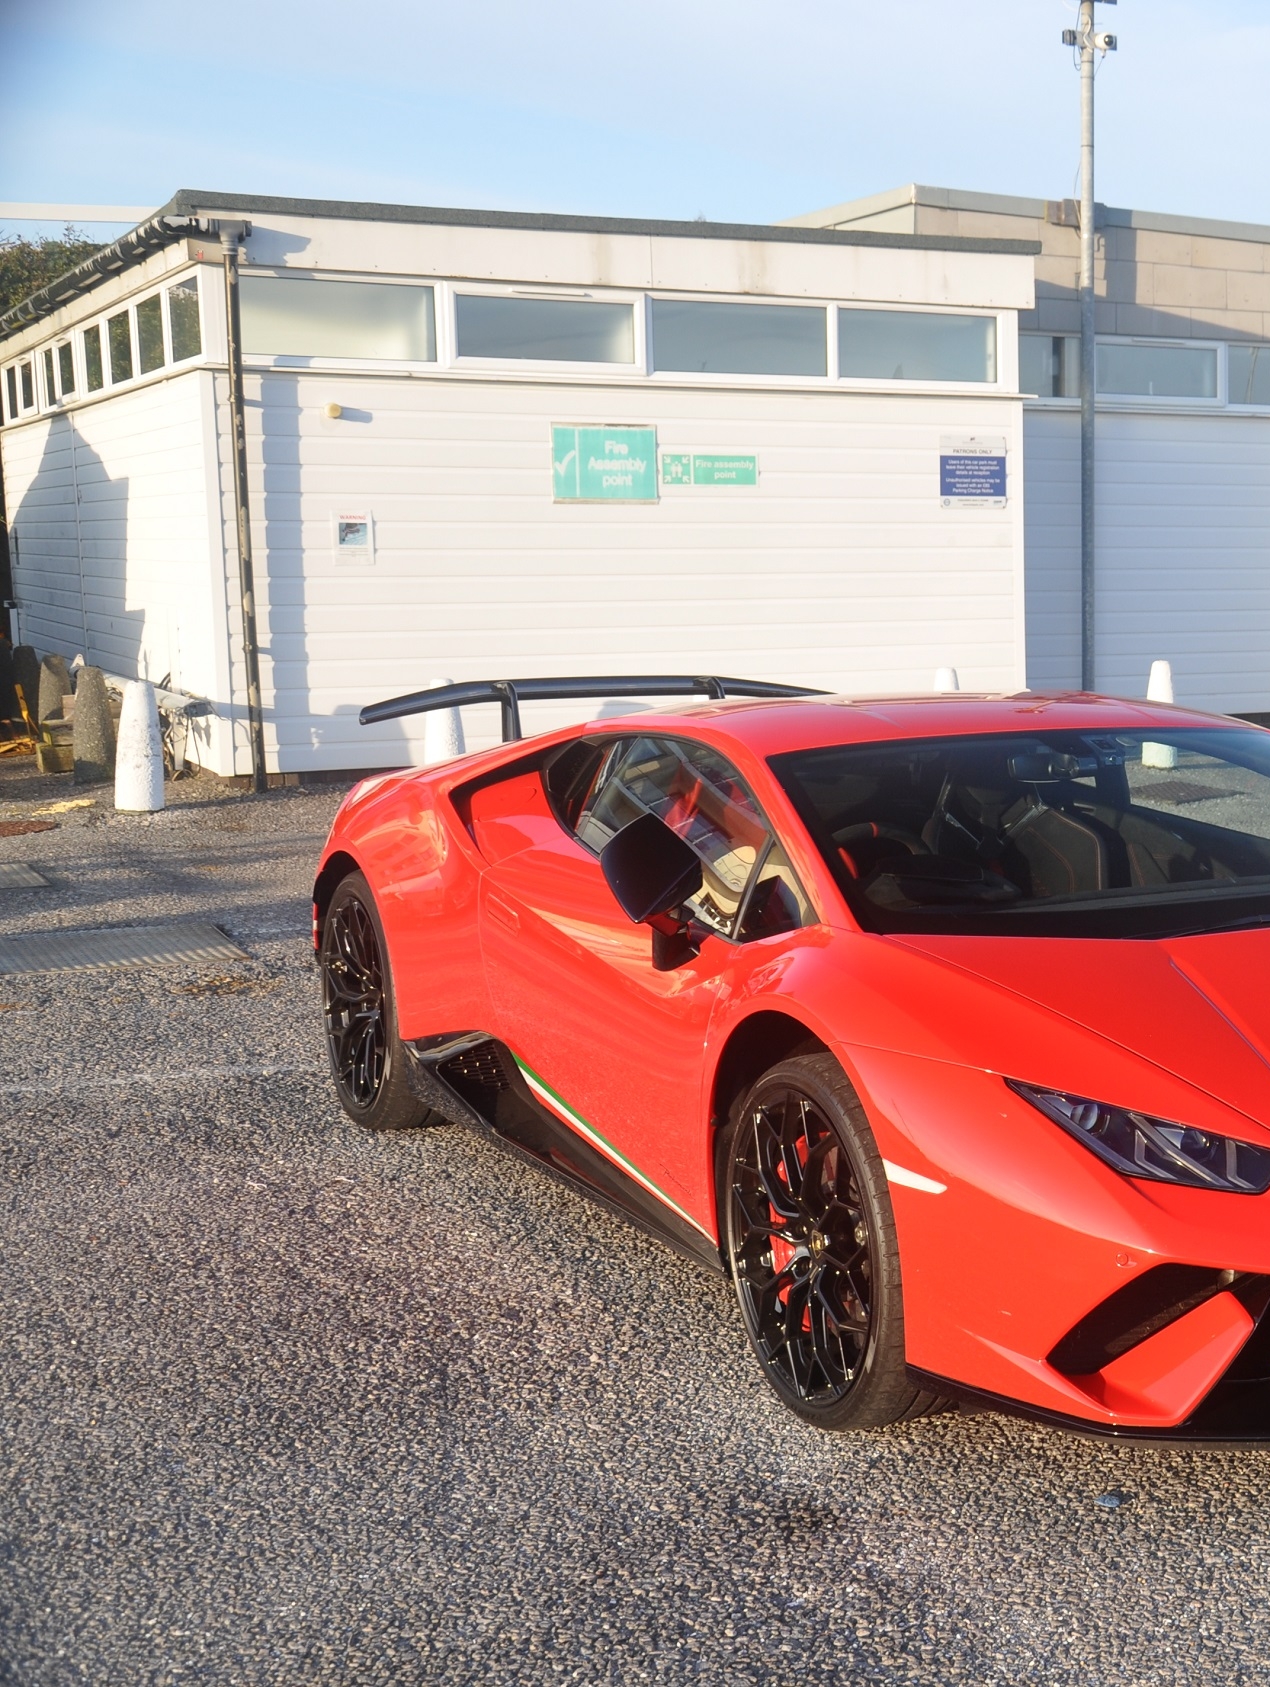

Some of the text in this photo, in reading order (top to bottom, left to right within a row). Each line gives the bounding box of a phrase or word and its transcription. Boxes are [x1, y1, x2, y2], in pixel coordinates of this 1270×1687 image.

[604, 440, 628, 455] Fire
[588, 456, 646, 473] Assembly
[695, 459, 754, 470] Fire assembly
[602, 473, 633, 488] point
[714, 470, 736, 480] point
